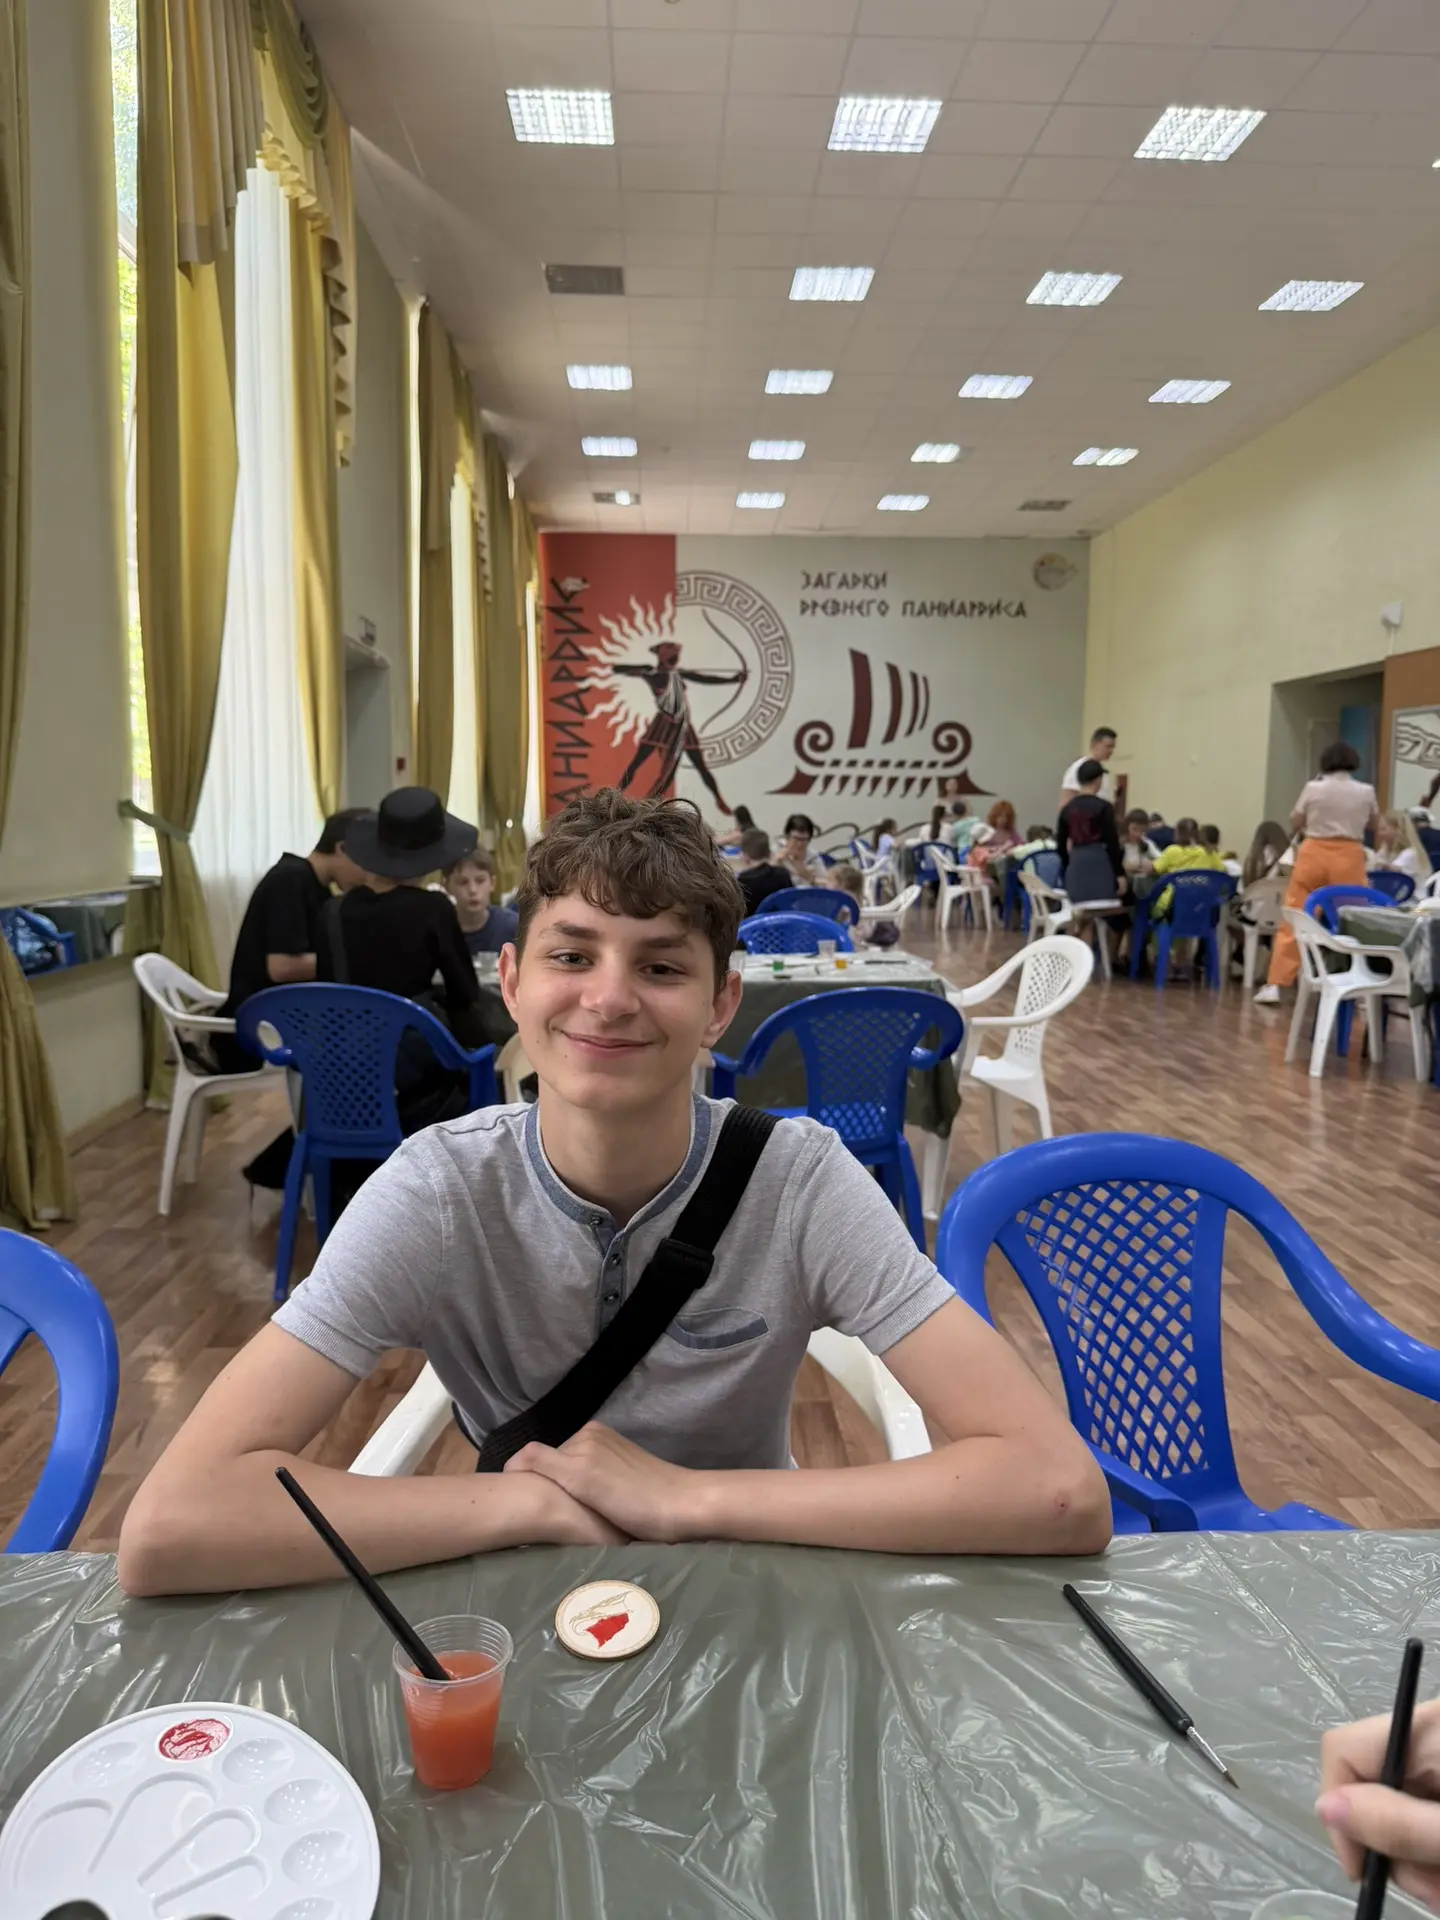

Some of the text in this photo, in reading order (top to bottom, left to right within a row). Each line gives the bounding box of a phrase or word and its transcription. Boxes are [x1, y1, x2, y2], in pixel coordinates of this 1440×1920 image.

[801, 571, 888, 591] ЗАГАДКИ
[800, 599, 890, 618] ДРЕВНЕГО
[547, 577, 594, 803] АНИАРДИС
